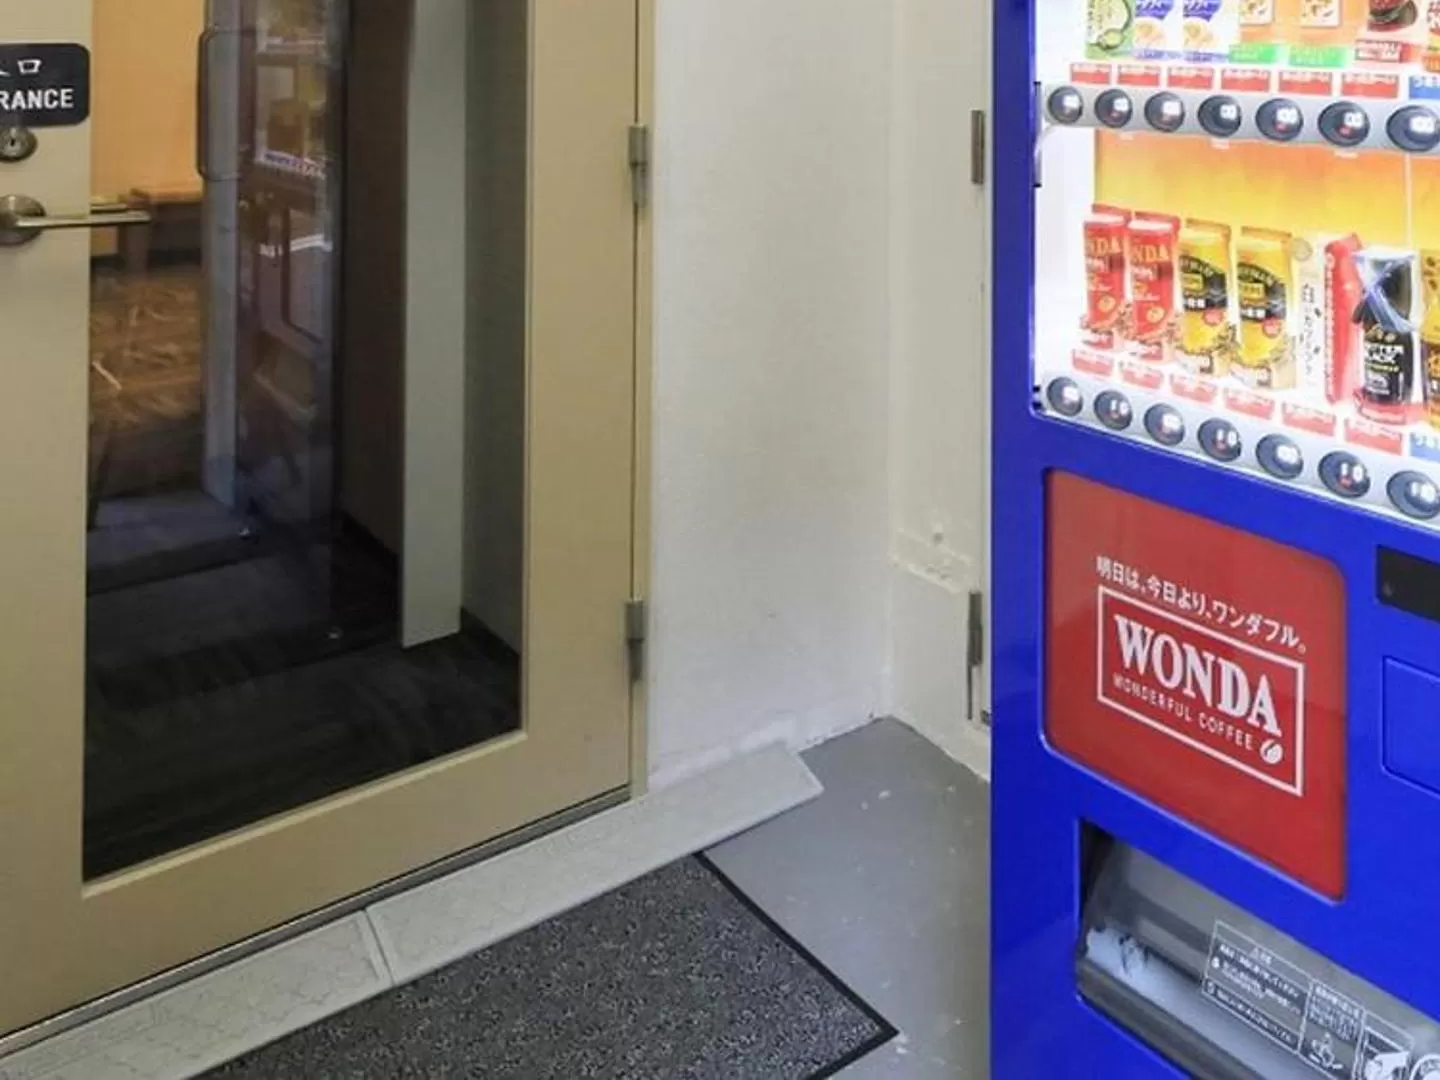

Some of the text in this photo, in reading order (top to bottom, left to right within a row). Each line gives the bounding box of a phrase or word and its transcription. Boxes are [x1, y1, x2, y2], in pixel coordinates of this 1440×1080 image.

[1112, 671, 1254, 751] WONDERFUL COFFEE
[1114, 613, 1282, 737] WONDA
